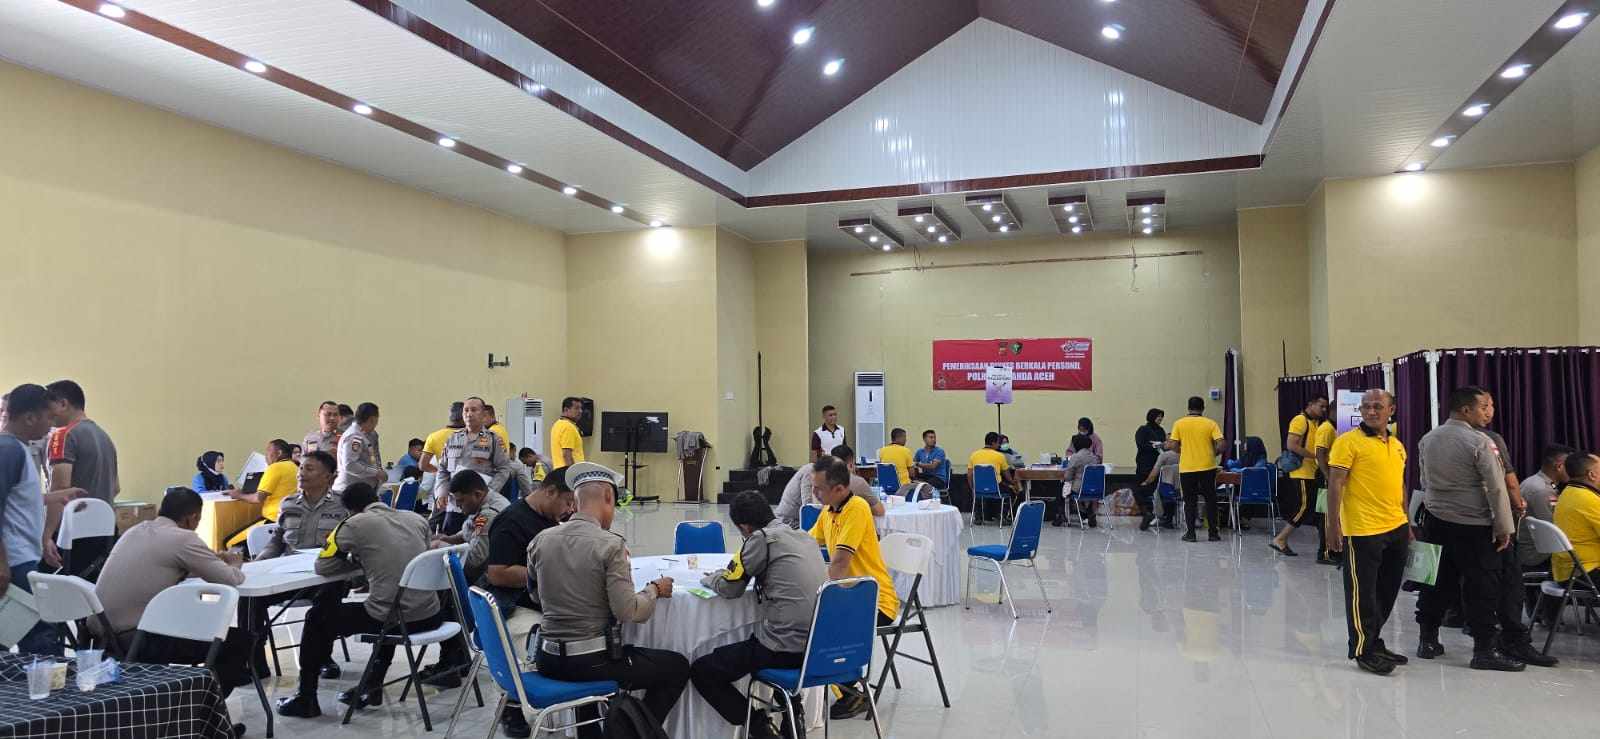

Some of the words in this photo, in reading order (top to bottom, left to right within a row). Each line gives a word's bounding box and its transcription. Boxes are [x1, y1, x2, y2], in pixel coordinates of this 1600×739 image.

[1016, 361, 1046, 370] BERKALA
[1047, 361, 1080, 370] PERSONIL
[1012, 372, 1032, 381] ANDA
[1034, 372, 1055, 381] ACEH
